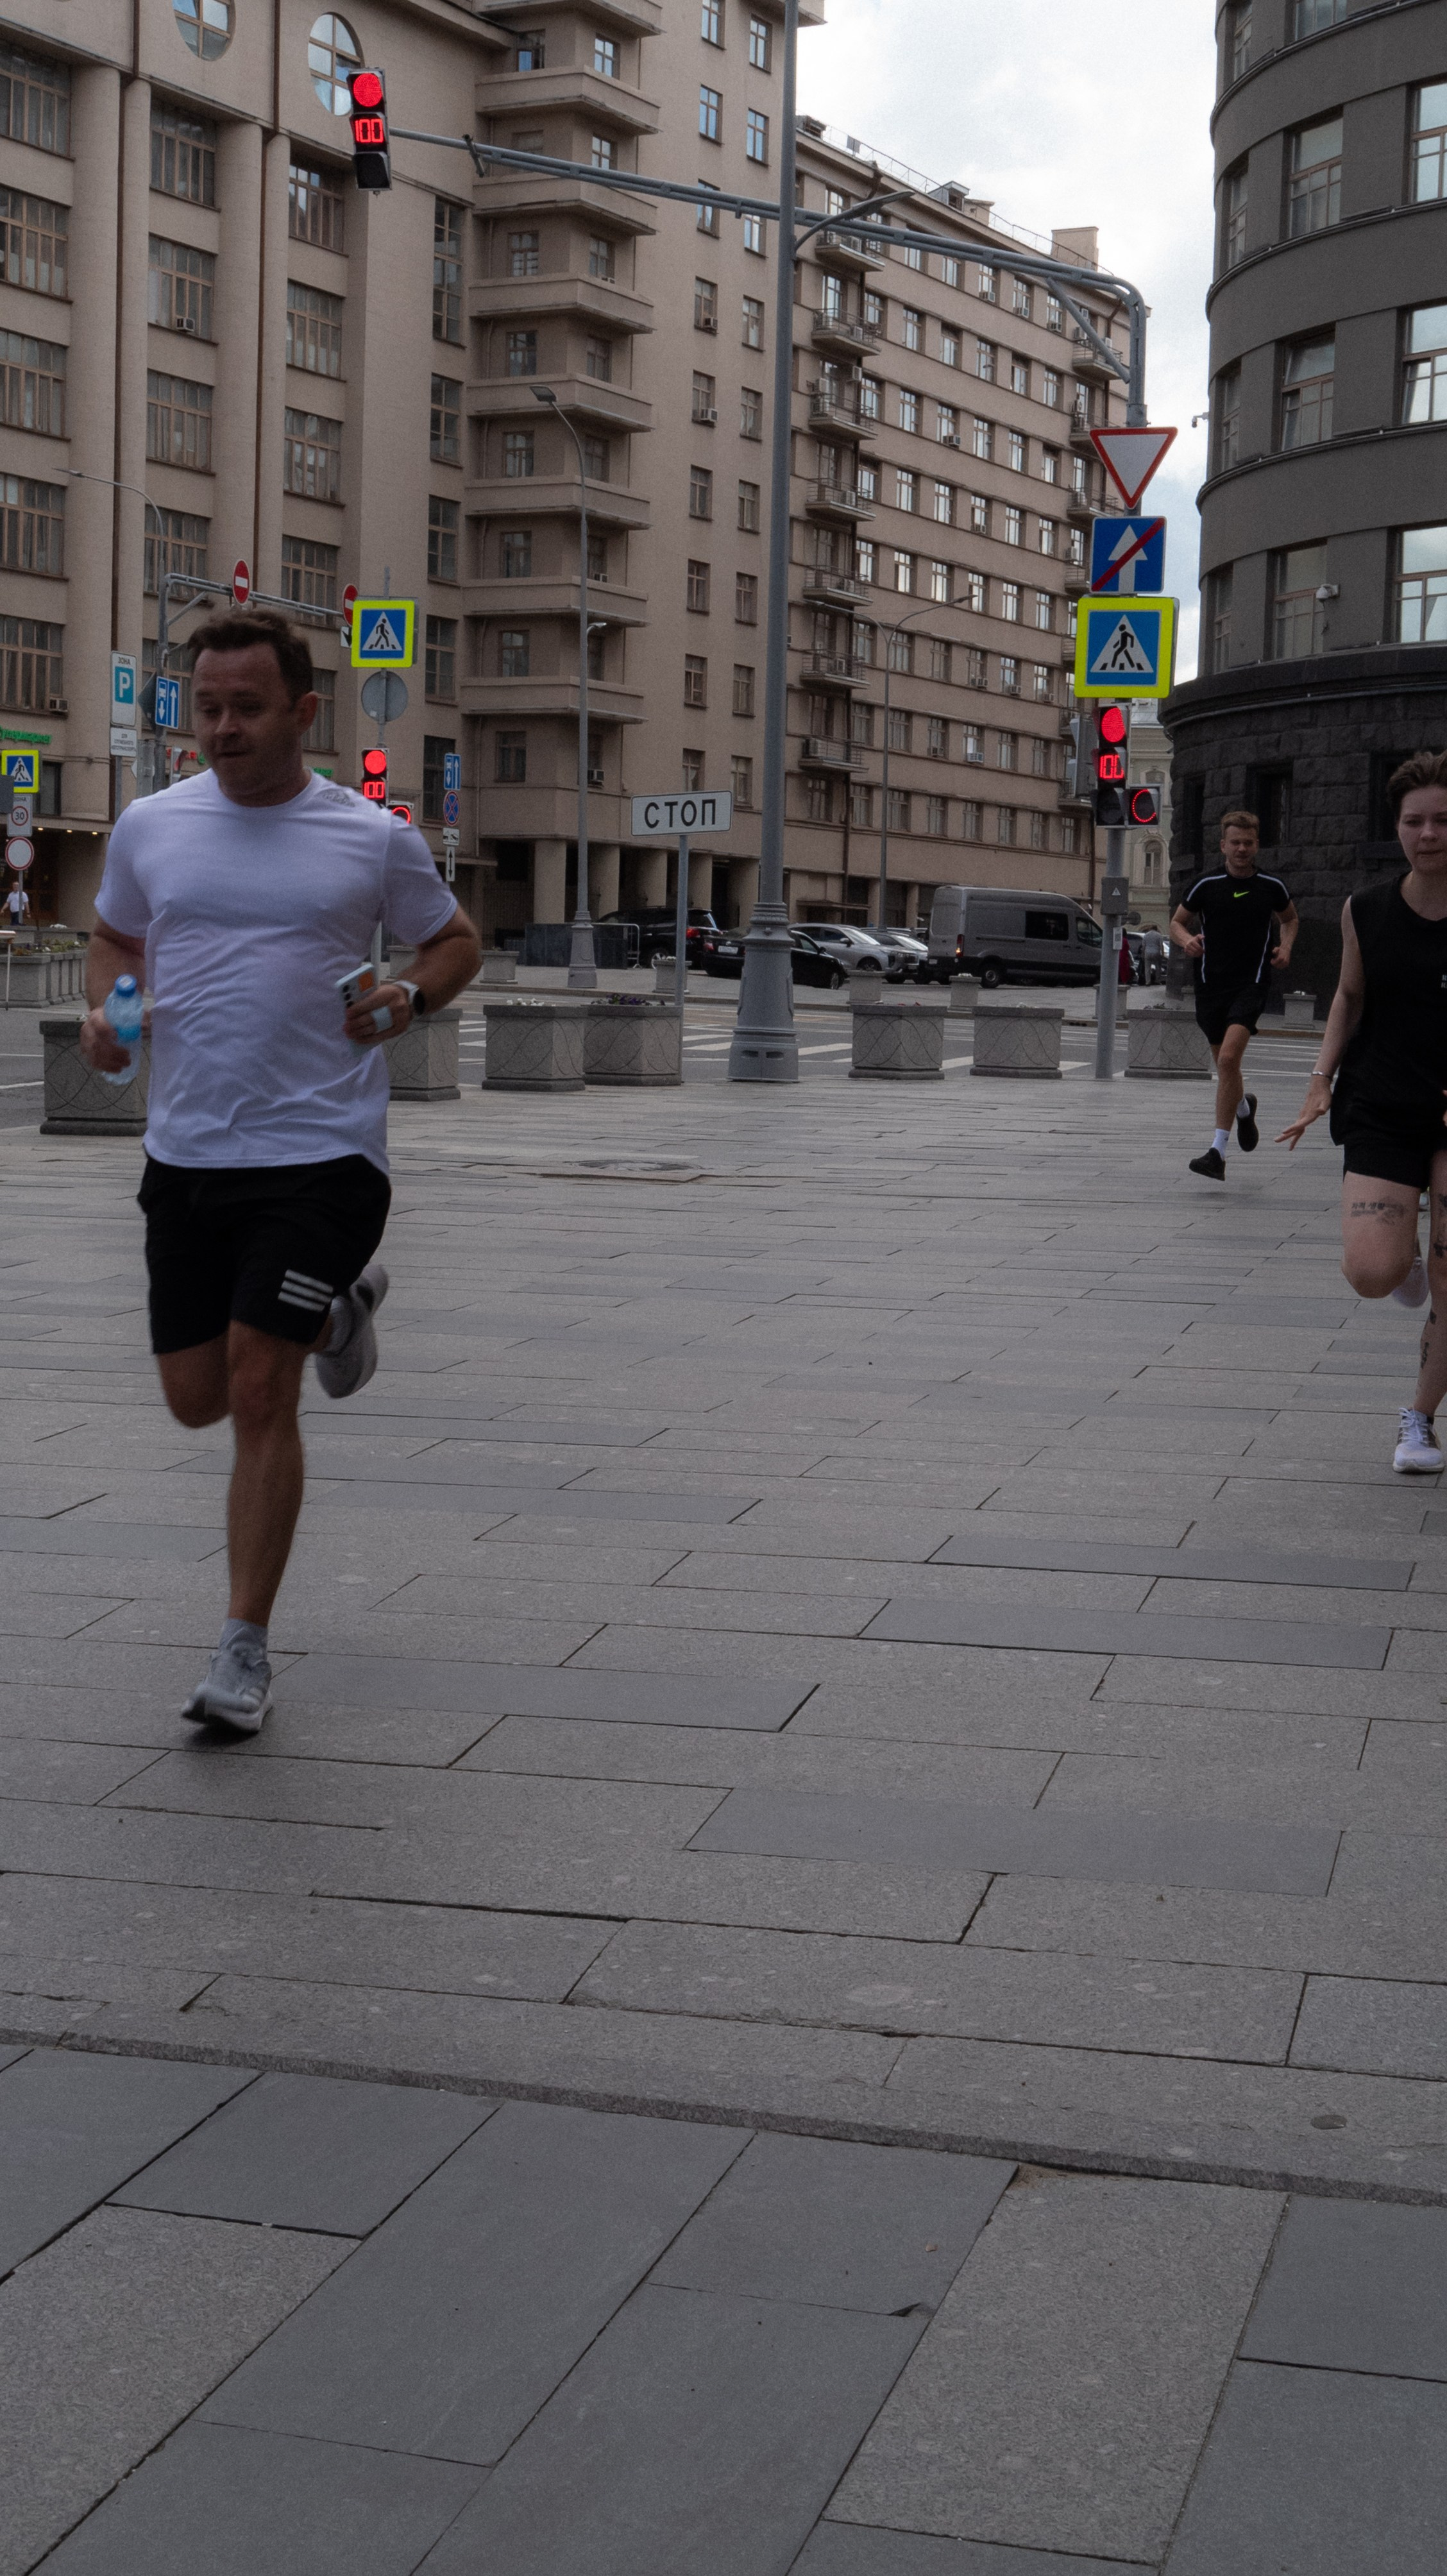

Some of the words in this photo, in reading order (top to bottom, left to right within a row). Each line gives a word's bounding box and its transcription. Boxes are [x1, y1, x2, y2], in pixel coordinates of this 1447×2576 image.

[355, 119, 384, 143] 100
[118, 656, 131, 666] ЗОНА
[119, 672, 131, 699] P
[15, 811, 25, 821] 30
[644, 799, 716, 829] СТОП
